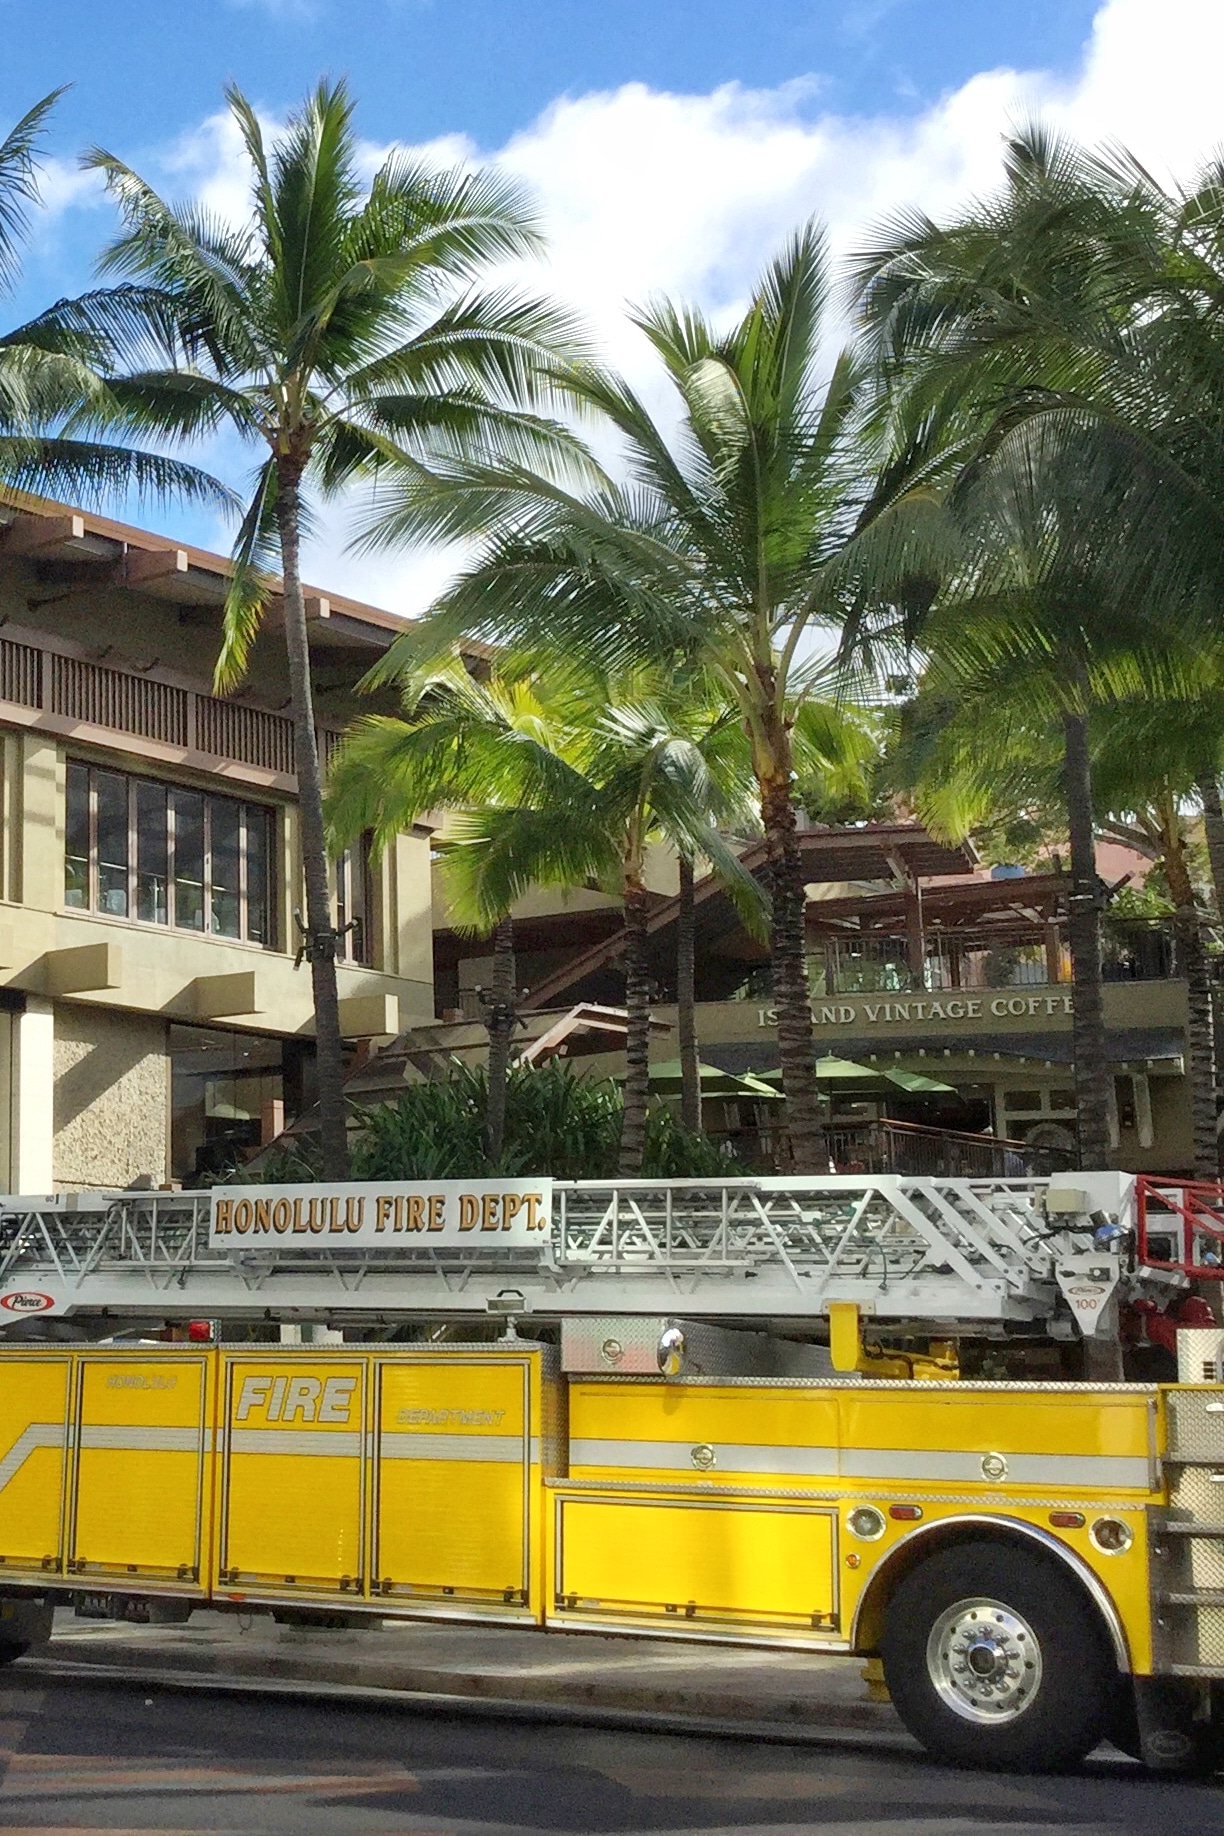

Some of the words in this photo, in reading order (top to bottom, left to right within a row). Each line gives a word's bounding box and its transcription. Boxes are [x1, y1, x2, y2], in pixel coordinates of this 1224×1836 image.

[863, 1000, 982, 1023] VINTAGE
[214, 1197, 365, 1234] HONOLULU
[374, 1195, 445, 1232] FIRE
[458, 1193, 547, 1231] DEPT.
[12, 1295, 42, 1308] Pierce
[236, 1375, 358, 1424] FIRE
[397, 1408, 506, 1427] DEPARTMENT
